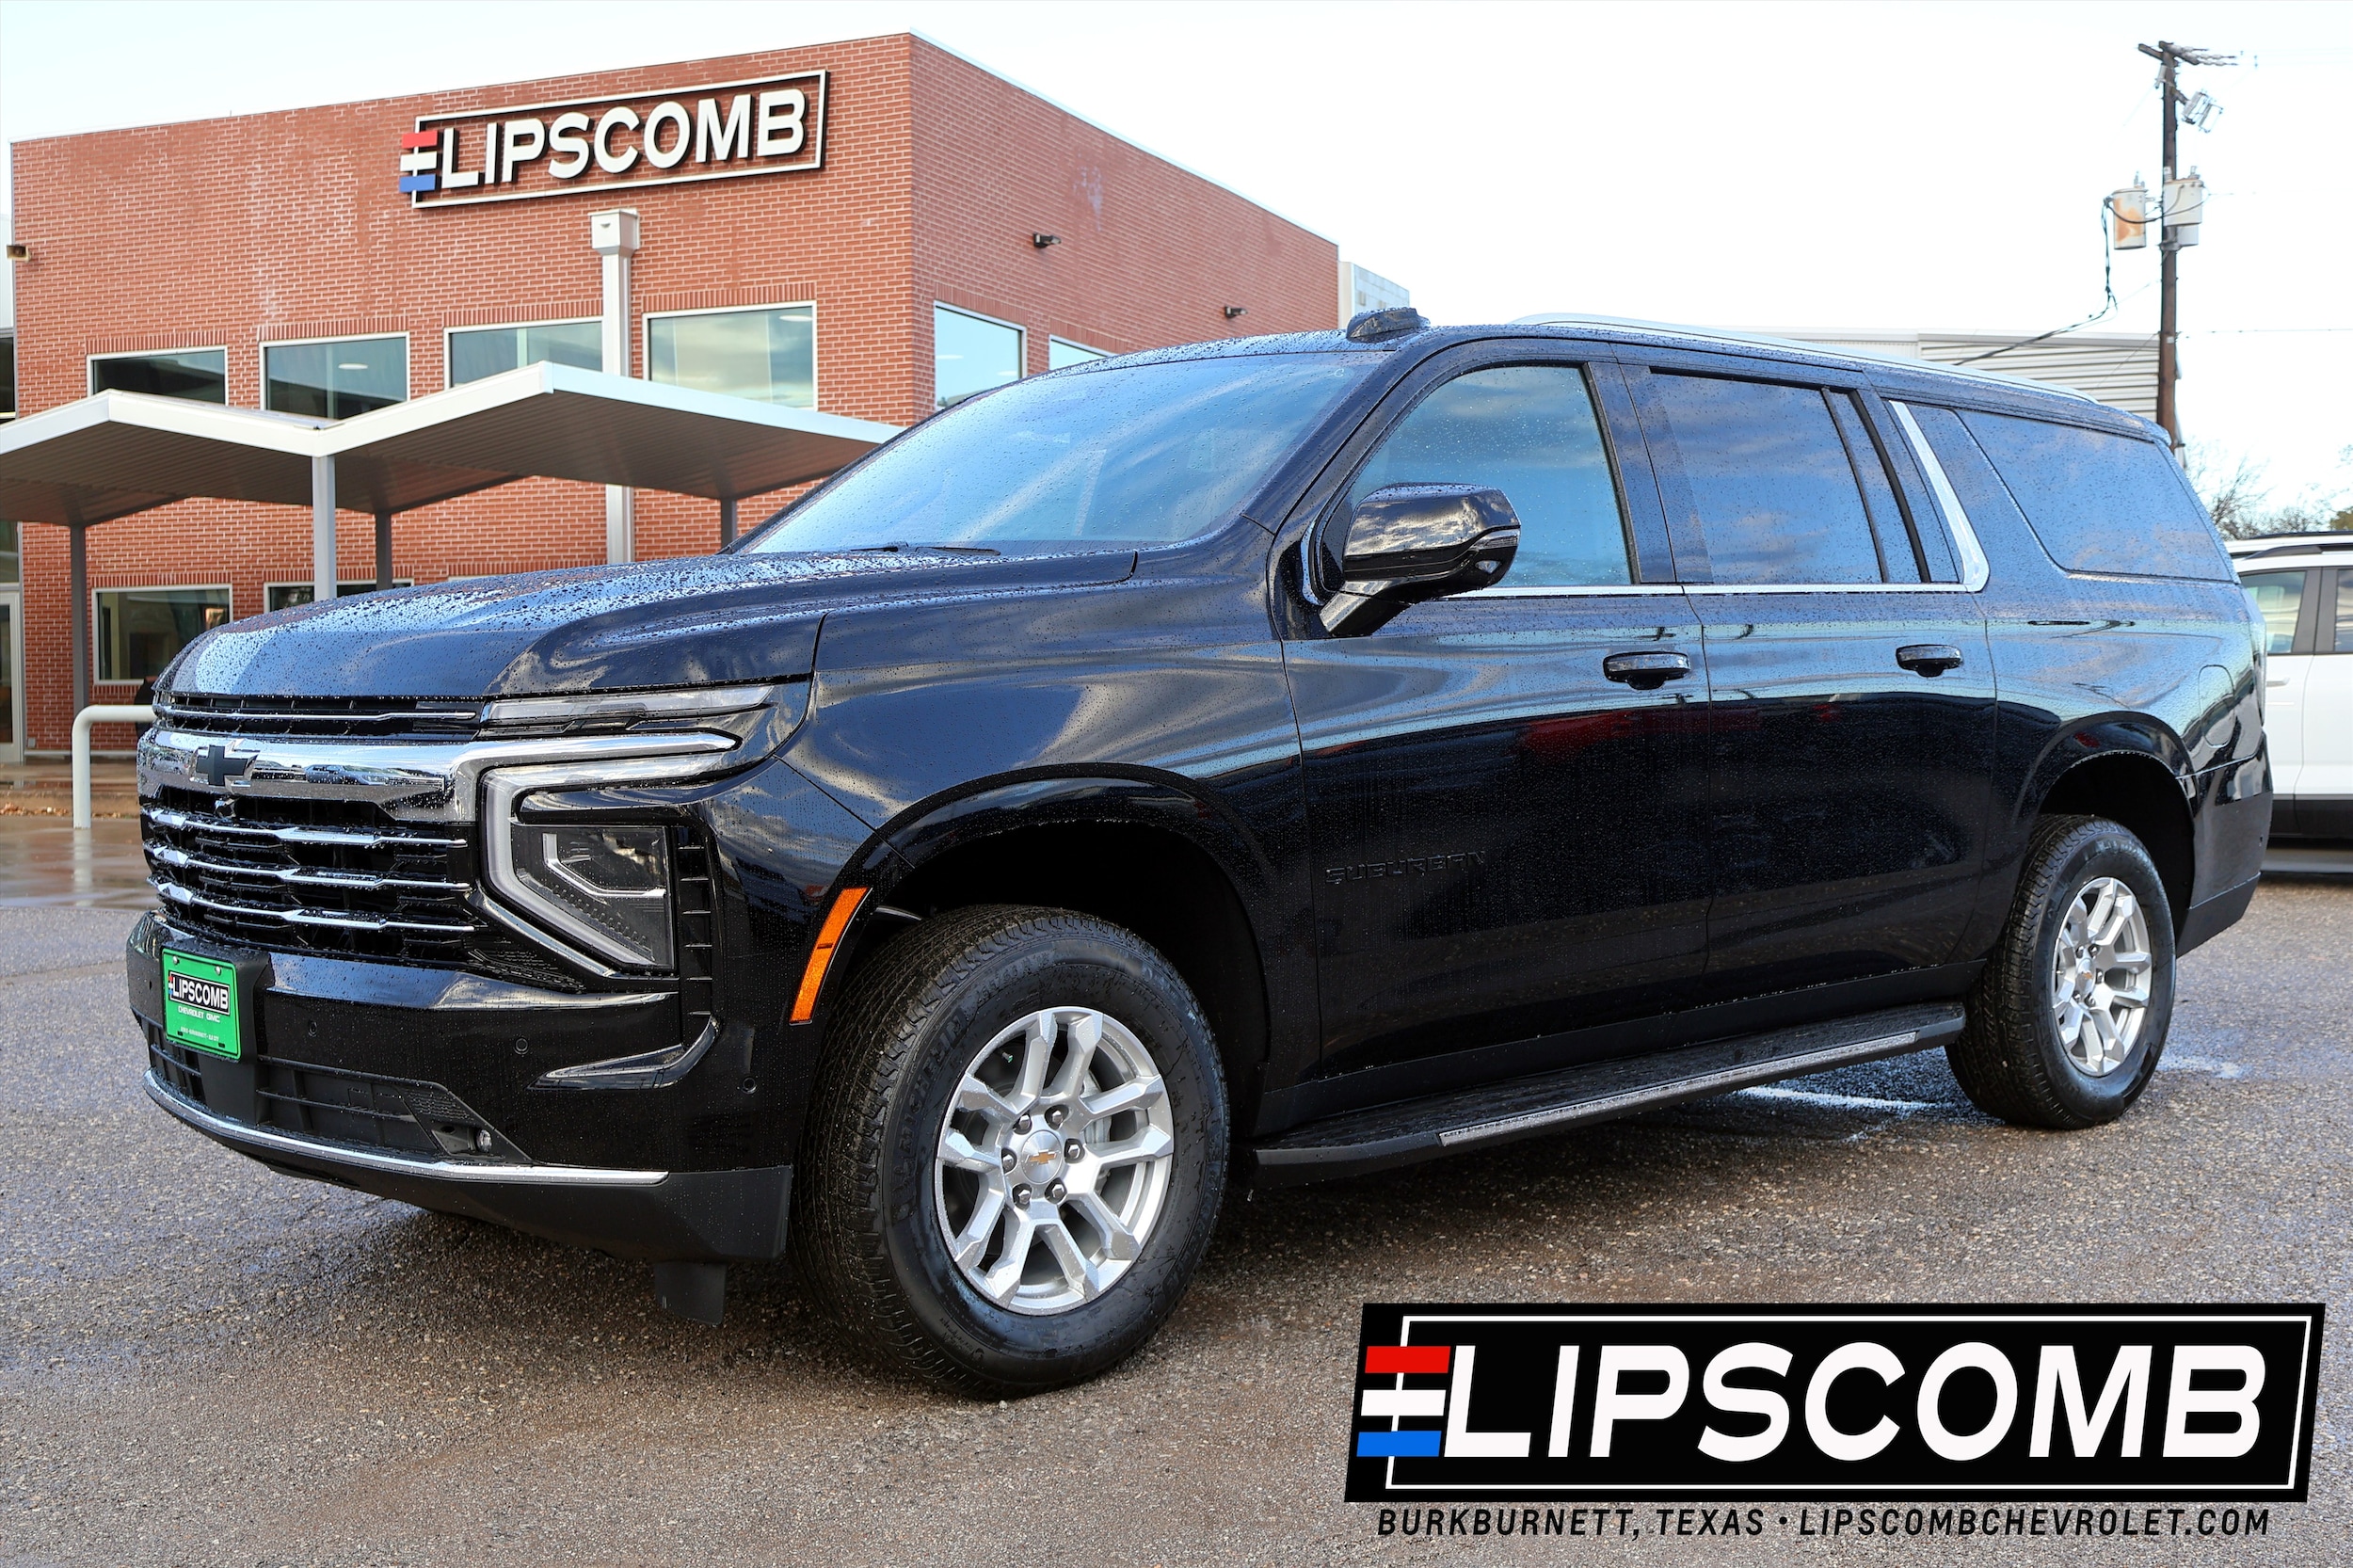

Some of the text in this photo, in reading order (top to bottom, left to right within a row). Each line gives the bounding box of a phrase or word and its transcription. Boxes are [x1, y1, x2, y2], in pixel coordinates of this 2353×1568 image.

[441, 88, 807, 190] LIPSCOMB
[1326, 851, 1484, 885] SUBURBAN
[172, 976, 229, 1010] LIPSCOMB
[205, 1013, 221, 1023] GMC
